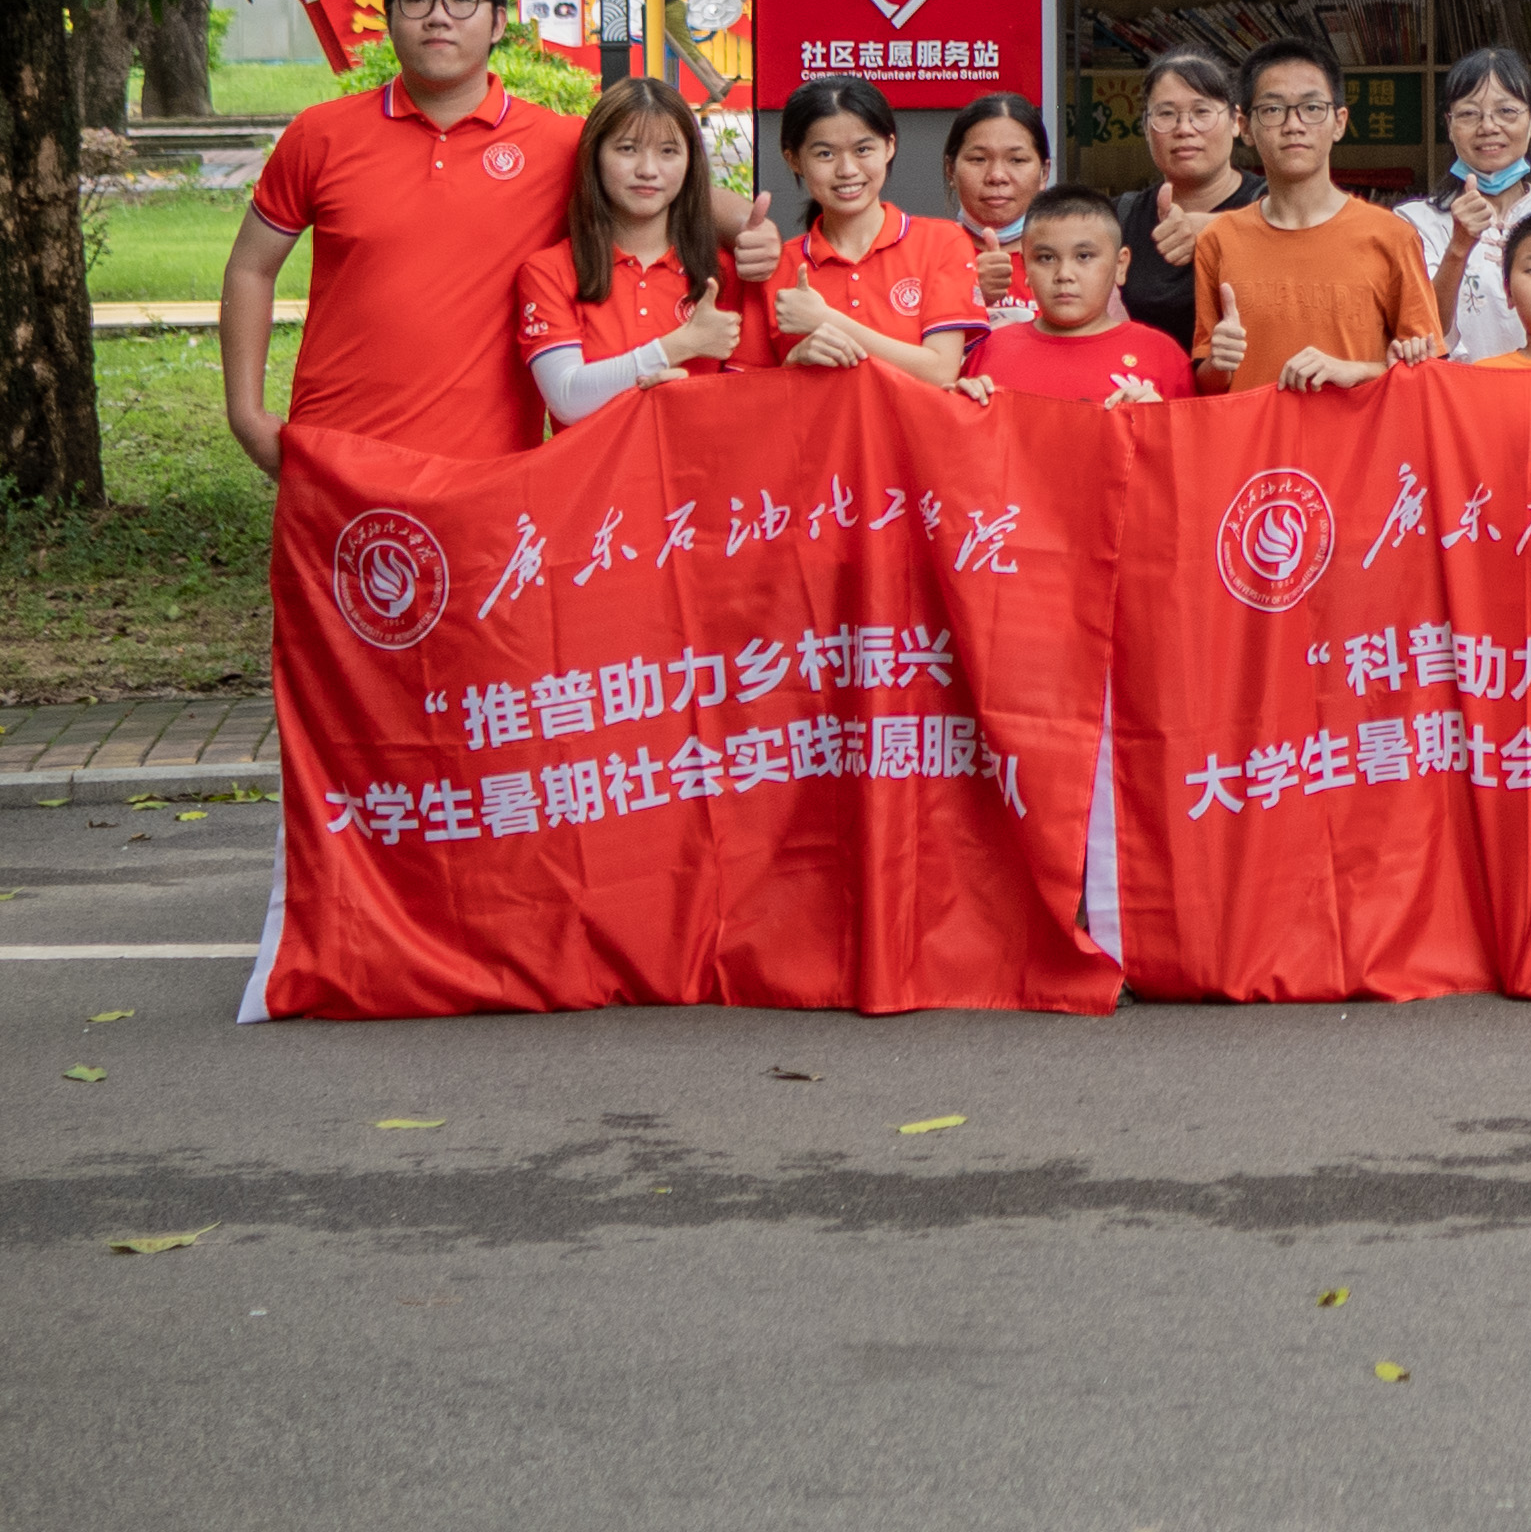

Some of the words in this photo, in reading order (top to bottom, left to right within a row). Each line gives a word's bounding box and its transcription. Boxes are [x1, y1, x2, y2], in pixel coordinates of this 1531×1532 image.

[801, 40, 999, 68] 社区志愿服务站
[863, 69, 916, 81] Volunteer
[917, 69, 958, 81] Service
[960, 69, 999, 80] Station
